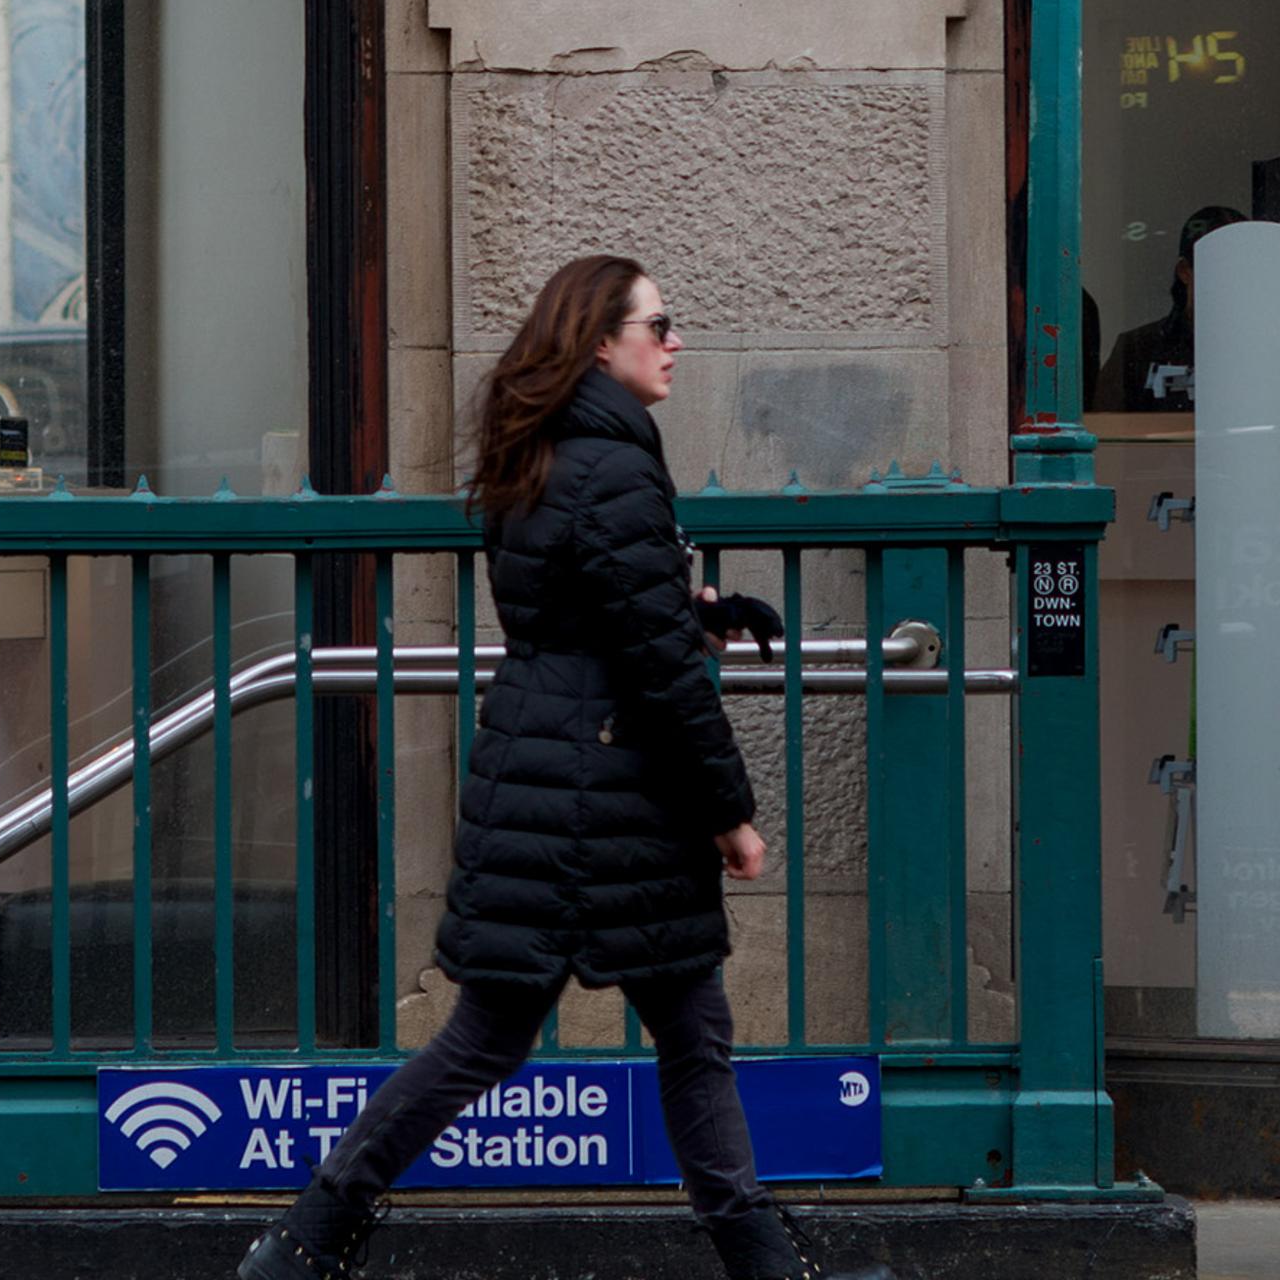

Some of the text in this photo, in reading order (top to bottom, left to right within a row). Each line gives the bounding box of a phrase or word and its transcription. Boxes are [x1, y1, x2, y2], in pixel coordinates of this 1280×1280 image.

[1033, 561, 1081, 575] 23 ST.
[1033, 597, 1077, 610] DWN-
[1033, 614, 1082, 628] TOWN
[239, 1077, 368, 1121] Wi-Fi
[238, 1127, 296, 1170] At
[429, 1124, 609, 1169] Station
